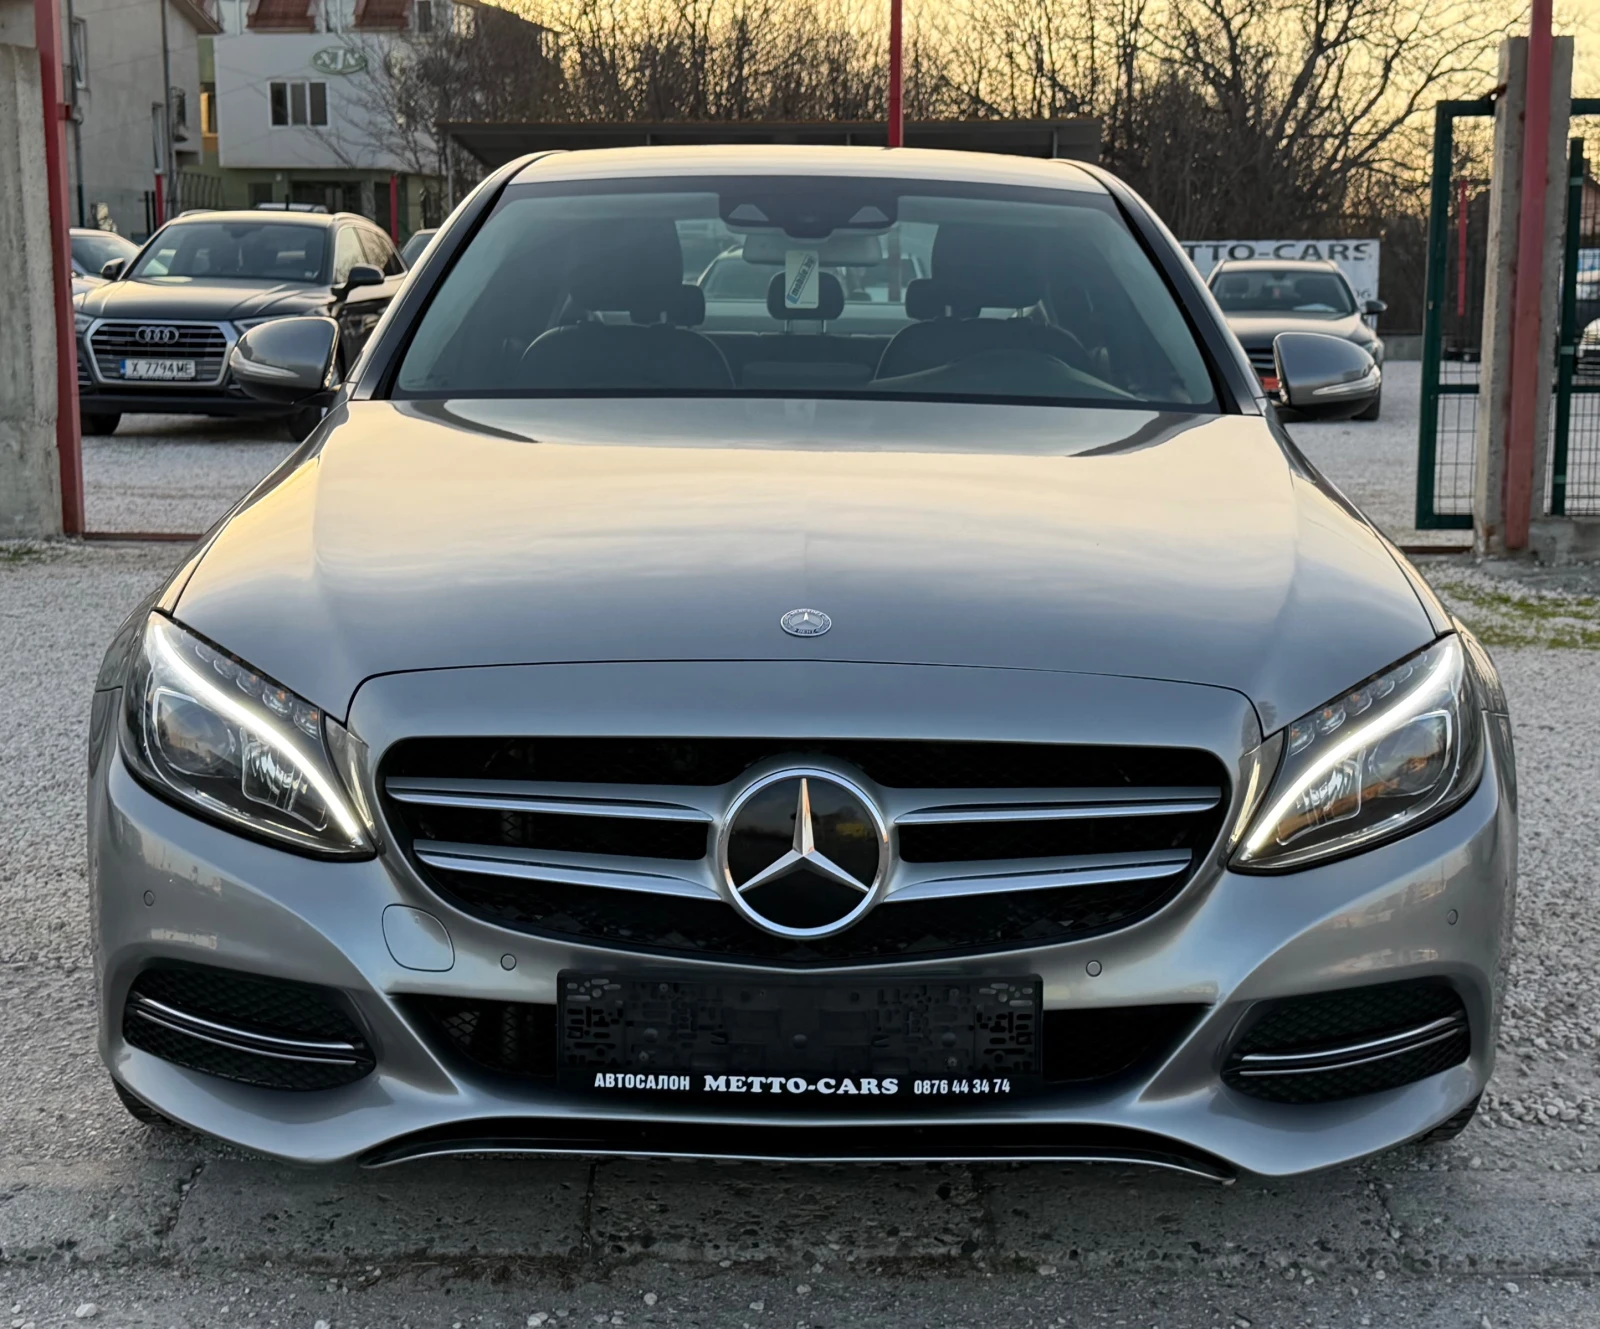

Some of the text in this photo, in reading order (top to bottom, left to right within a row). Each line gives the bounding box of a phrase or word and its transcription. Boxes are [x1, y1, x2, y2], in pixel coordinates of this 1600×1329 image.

[594, 1073, 1011, 1095] АВТОСАЛОН METTO-CARS 0876 44 34 74
